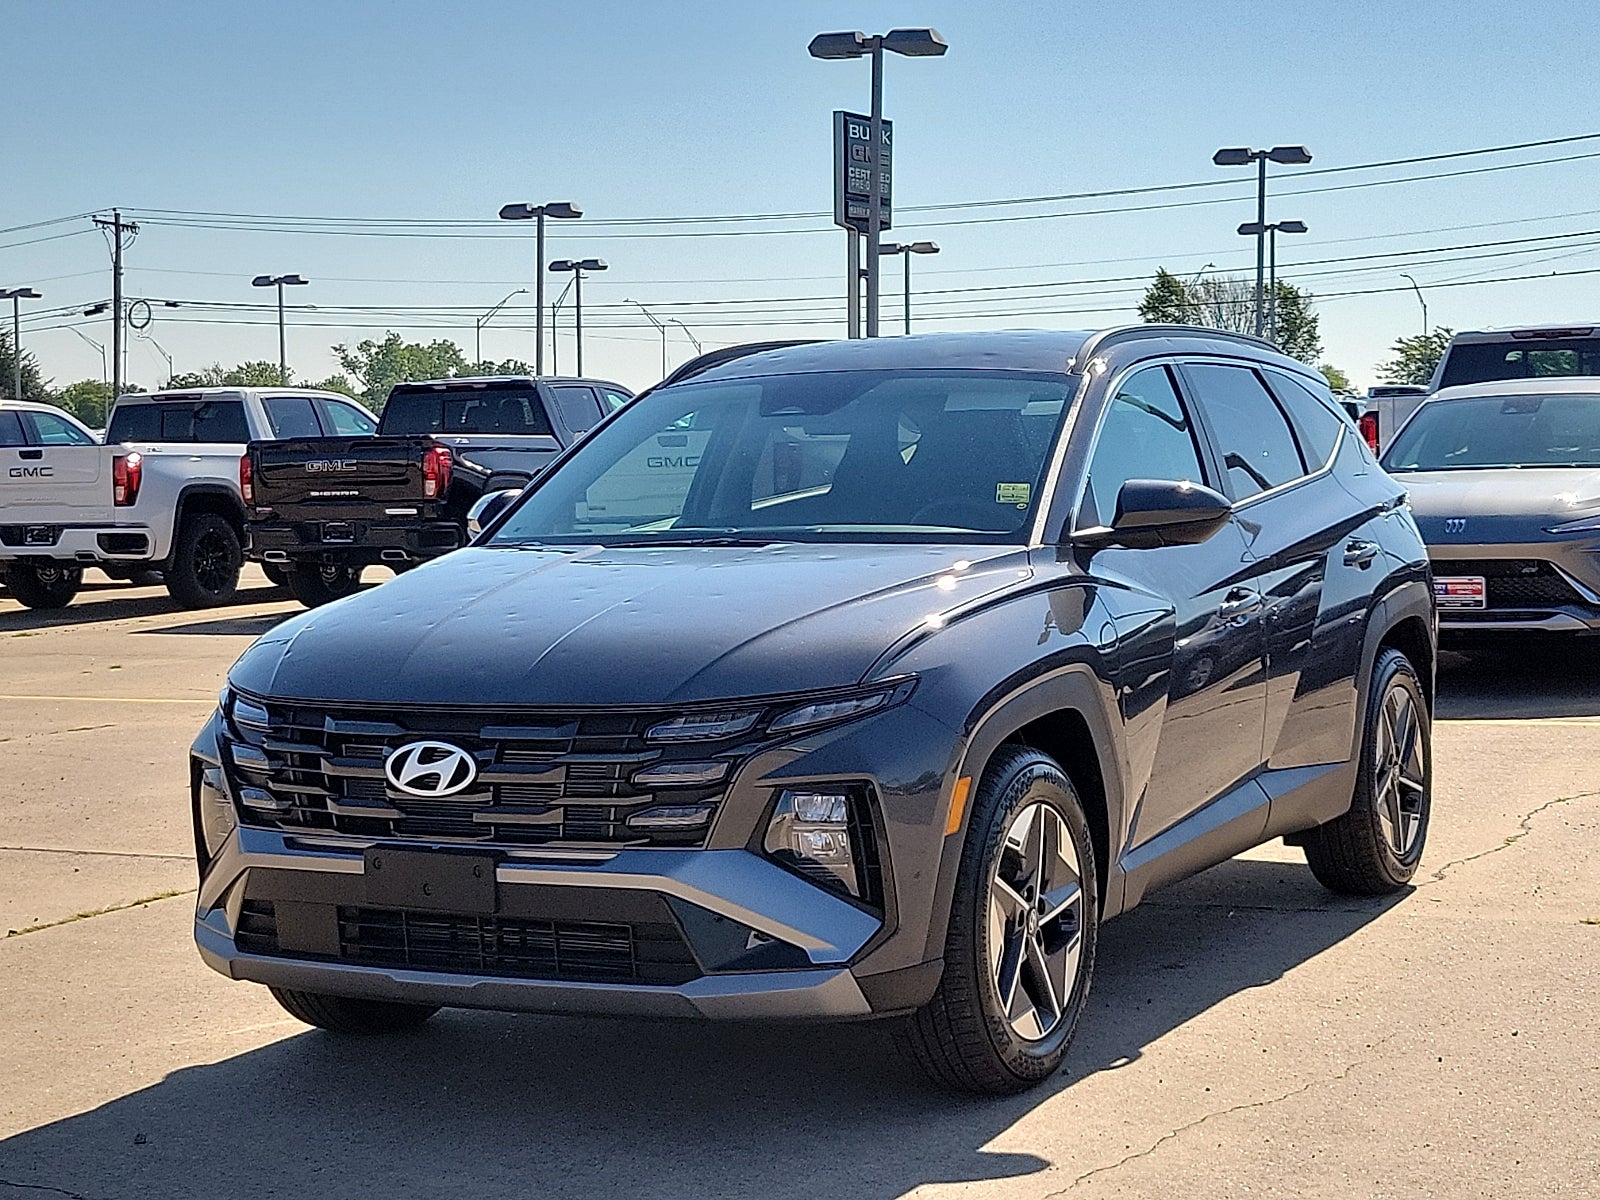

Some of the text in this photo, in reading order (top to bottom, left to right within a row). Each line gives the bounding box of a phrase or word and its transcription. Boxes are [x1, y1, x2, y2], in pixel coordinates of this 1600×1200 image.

[849, 124, 891, 145] BUK
[848, 166, 891, 184] CERTED
[851, 178, 889, 194] PRE-OED
[306, 459, 357, 473] GMC
[647, 456, 700, 468] GMC
[9, 466, 54, 478] GMC
